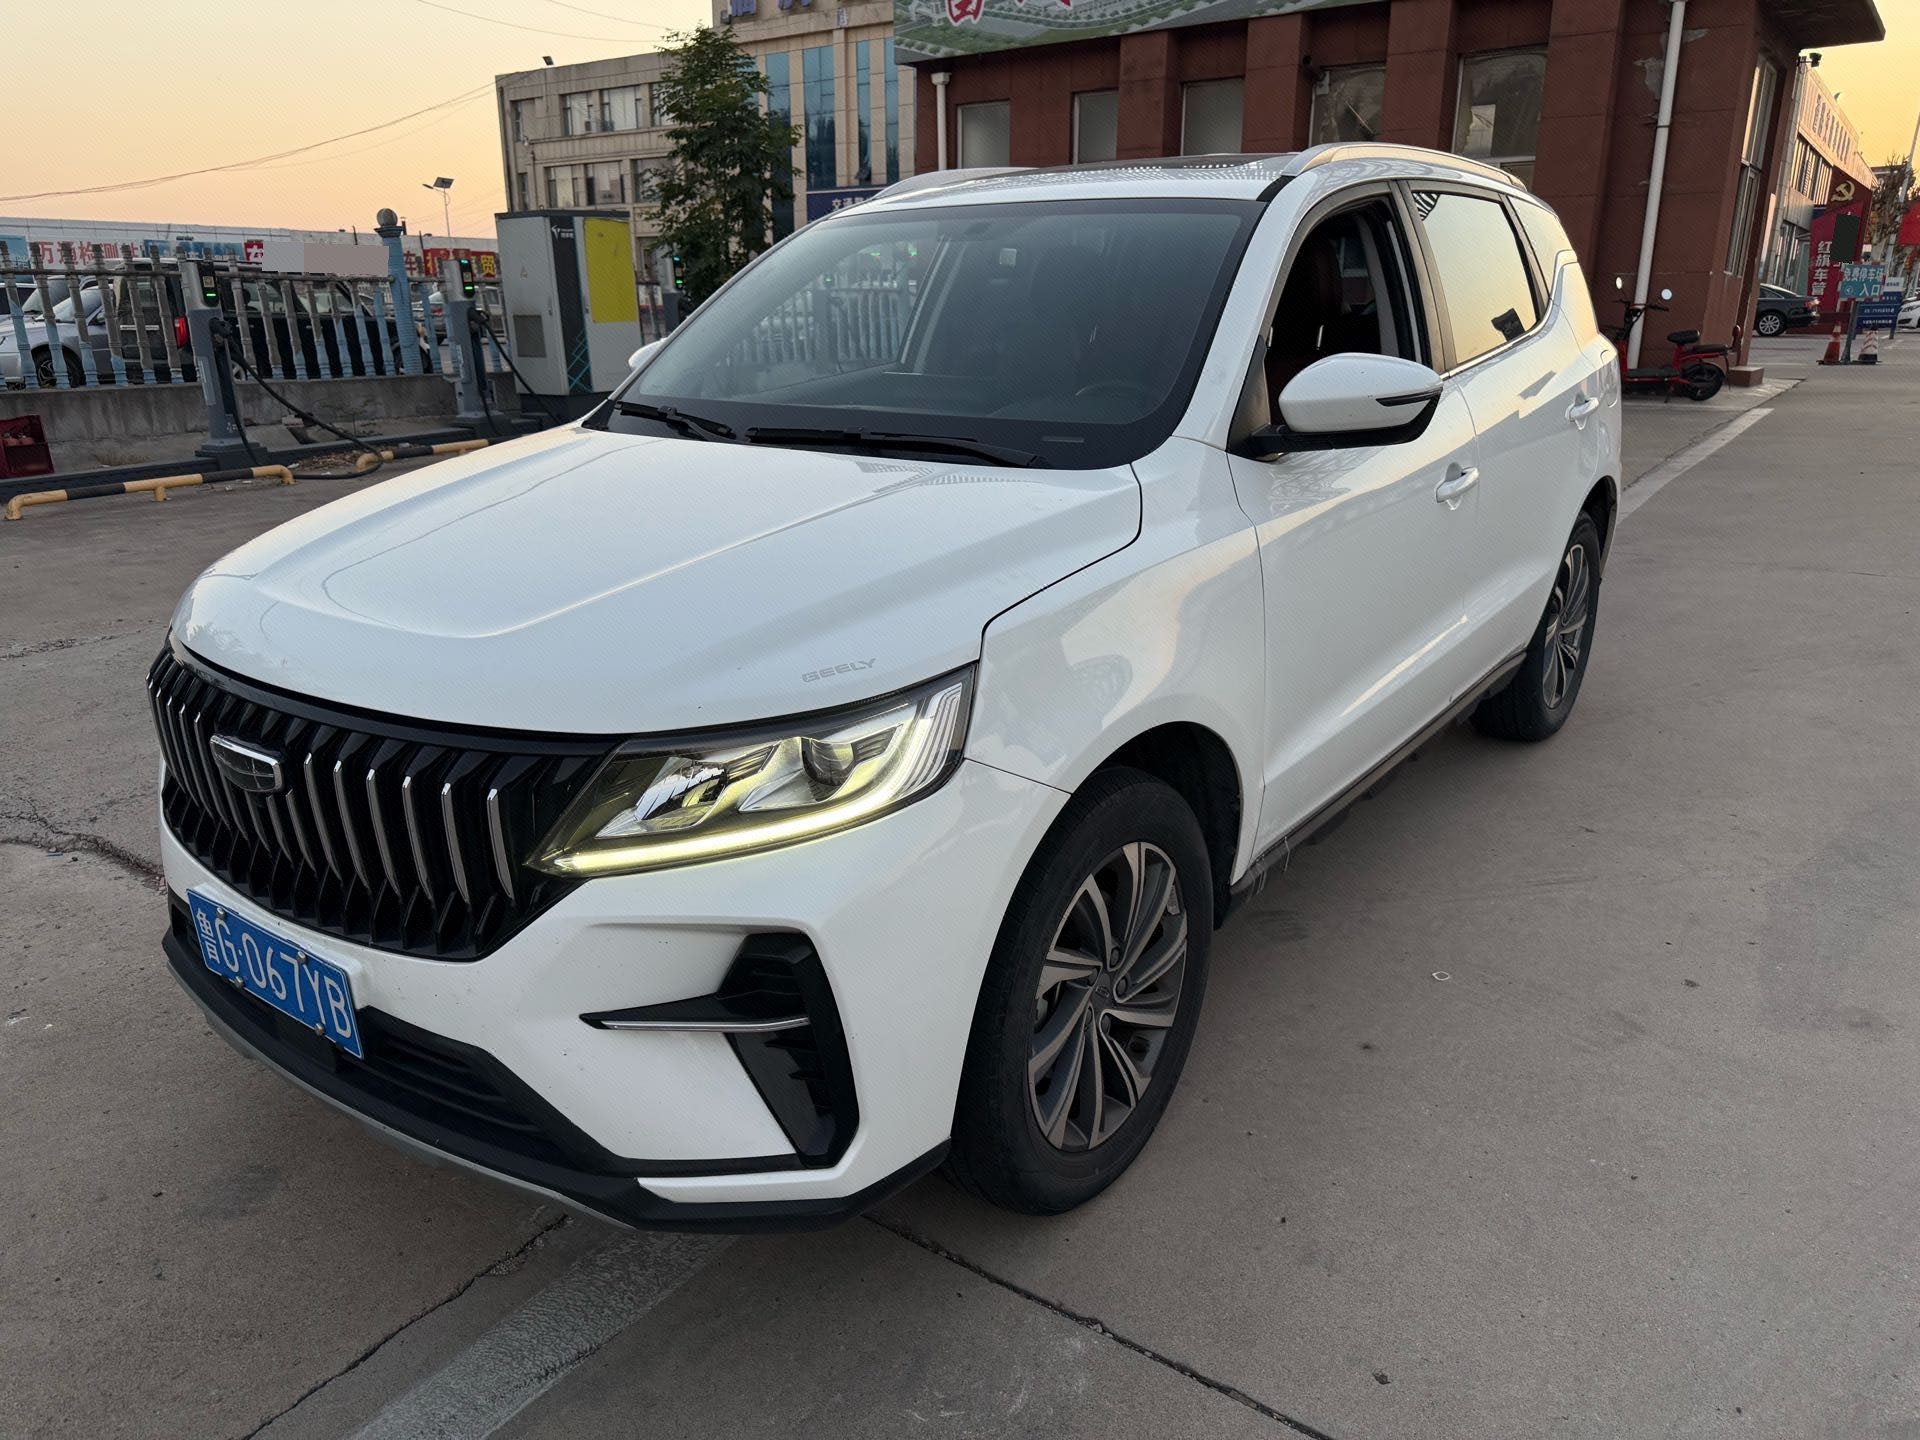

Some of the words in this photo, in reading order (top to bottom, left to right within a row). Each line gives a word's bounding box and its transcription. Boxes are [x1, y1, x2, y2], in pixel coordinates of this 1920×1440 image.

[1844, 267, 1883, 282] 免费停车场
[1859, 283, 1880, 297] 入口
[801, 658, 876, 682] GEELY
